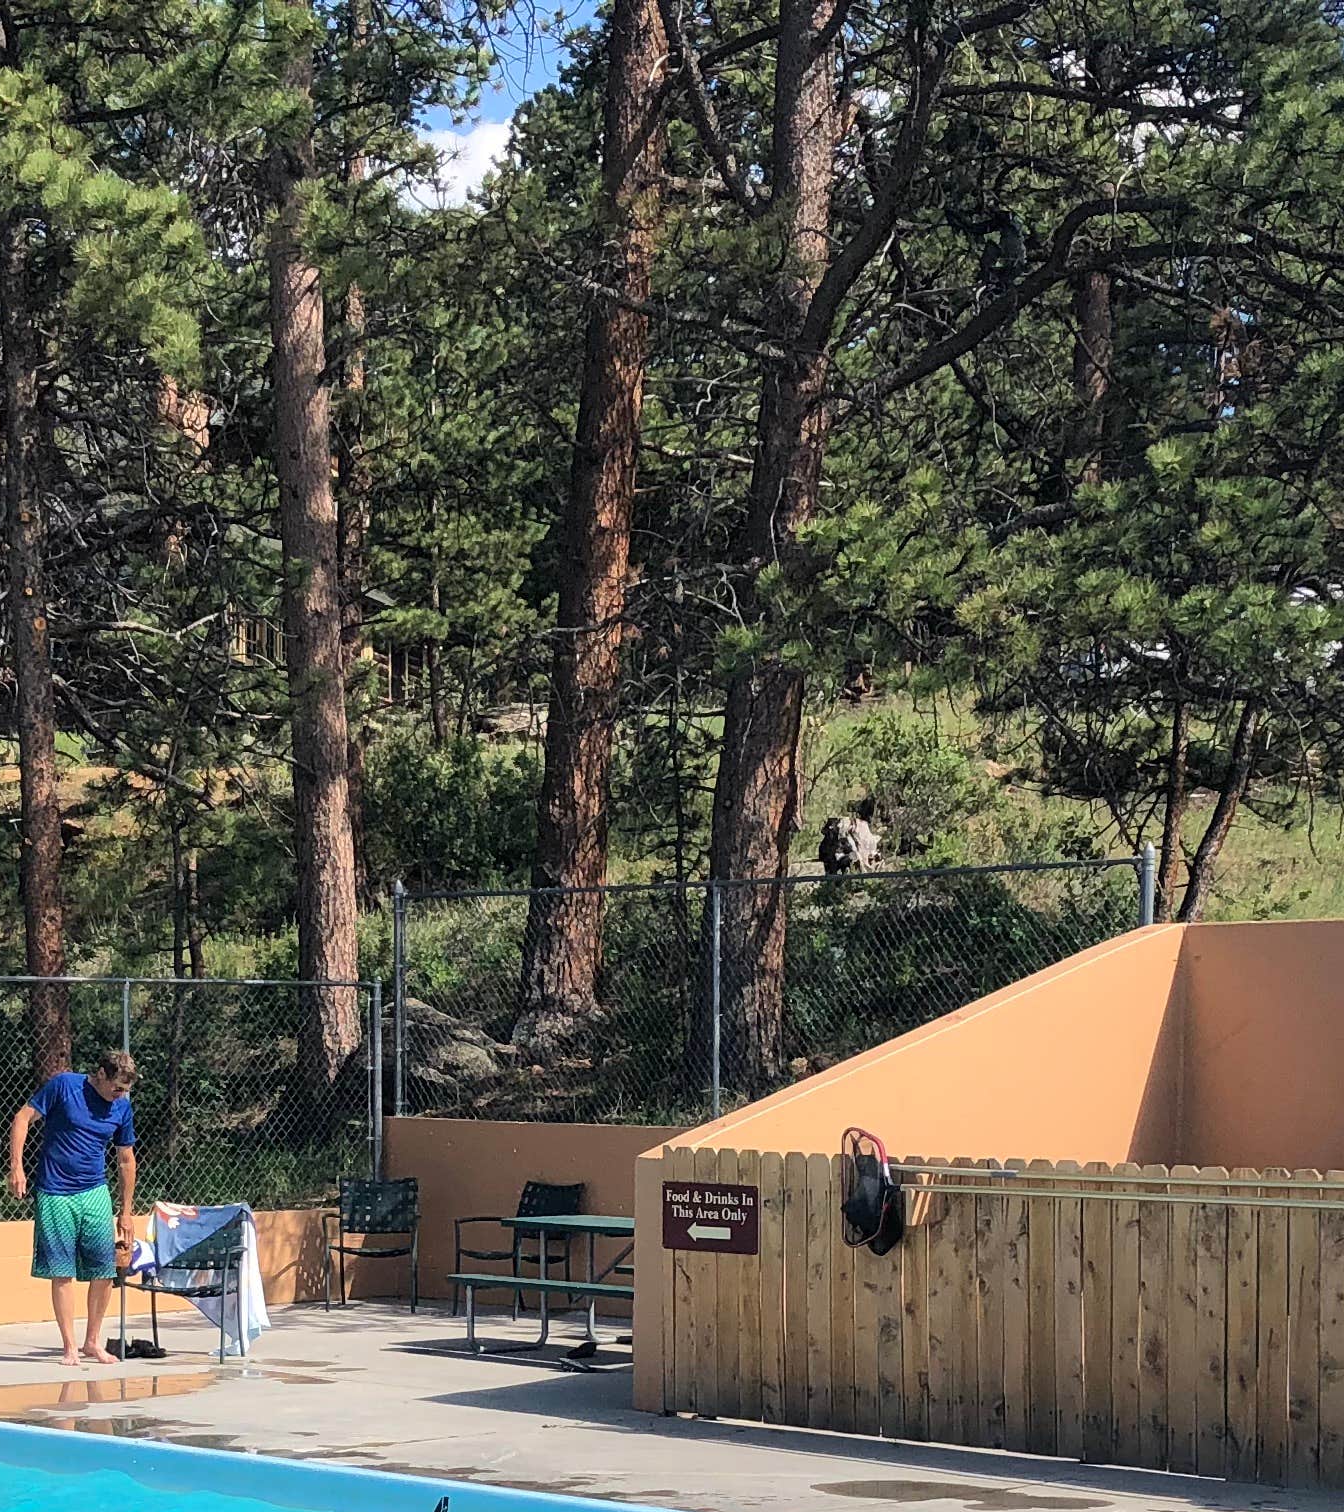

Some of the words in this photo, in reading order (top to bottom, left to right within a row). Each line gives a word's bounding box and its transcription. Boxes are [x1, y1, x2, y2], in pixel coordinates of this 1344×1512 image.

[665, 1189, 690, 1203] Food
[692, 1190, 702, 1203] &
[704, 1191, 739, 1206] Drinks
[741, 1193, 754, 1206] In
[671, 1205, 694, 1219] This
[696, 1207, 719, 1220] Area
[721, 1207, 748, 1226] Only
